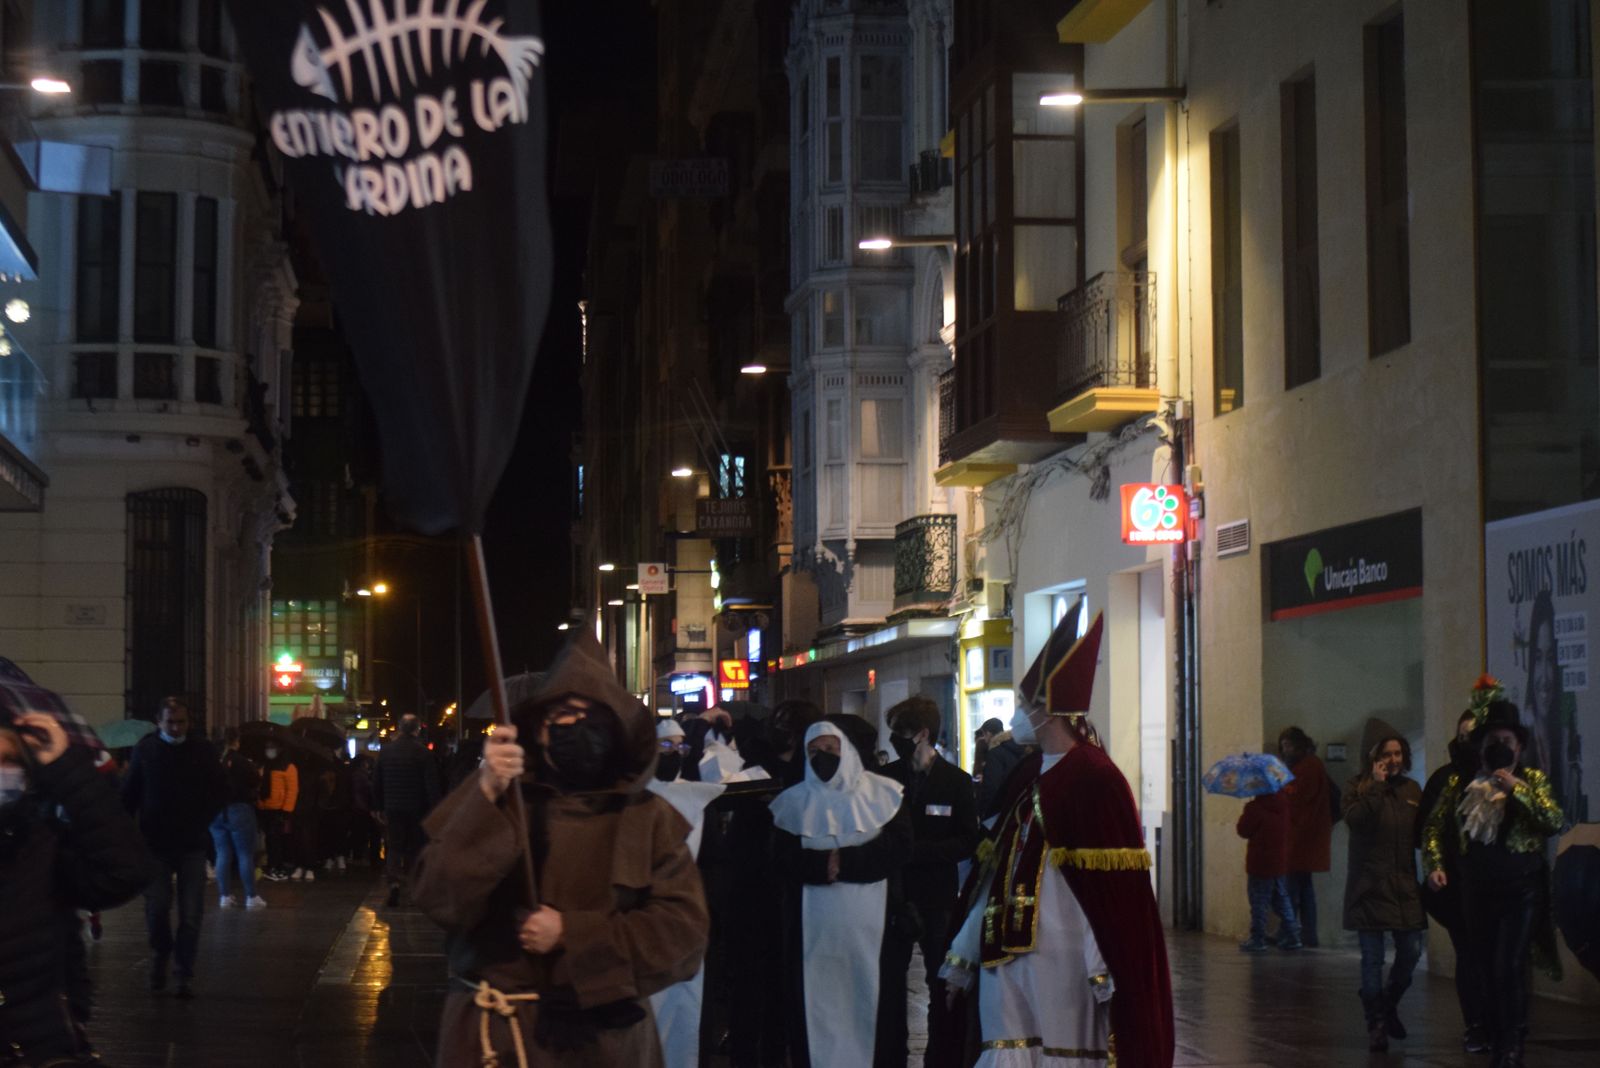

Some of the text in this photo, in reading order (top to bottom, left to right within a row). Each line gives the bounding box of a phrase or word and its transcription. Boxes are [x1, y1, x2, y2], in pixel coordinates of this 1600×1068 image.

[414, 86, 465, 149] DE
[470, 76, 521, 132] LA
[1358, 558, 1388, 584] Banco
[1507, 530, 1587, 604] SOMOS MÁS
